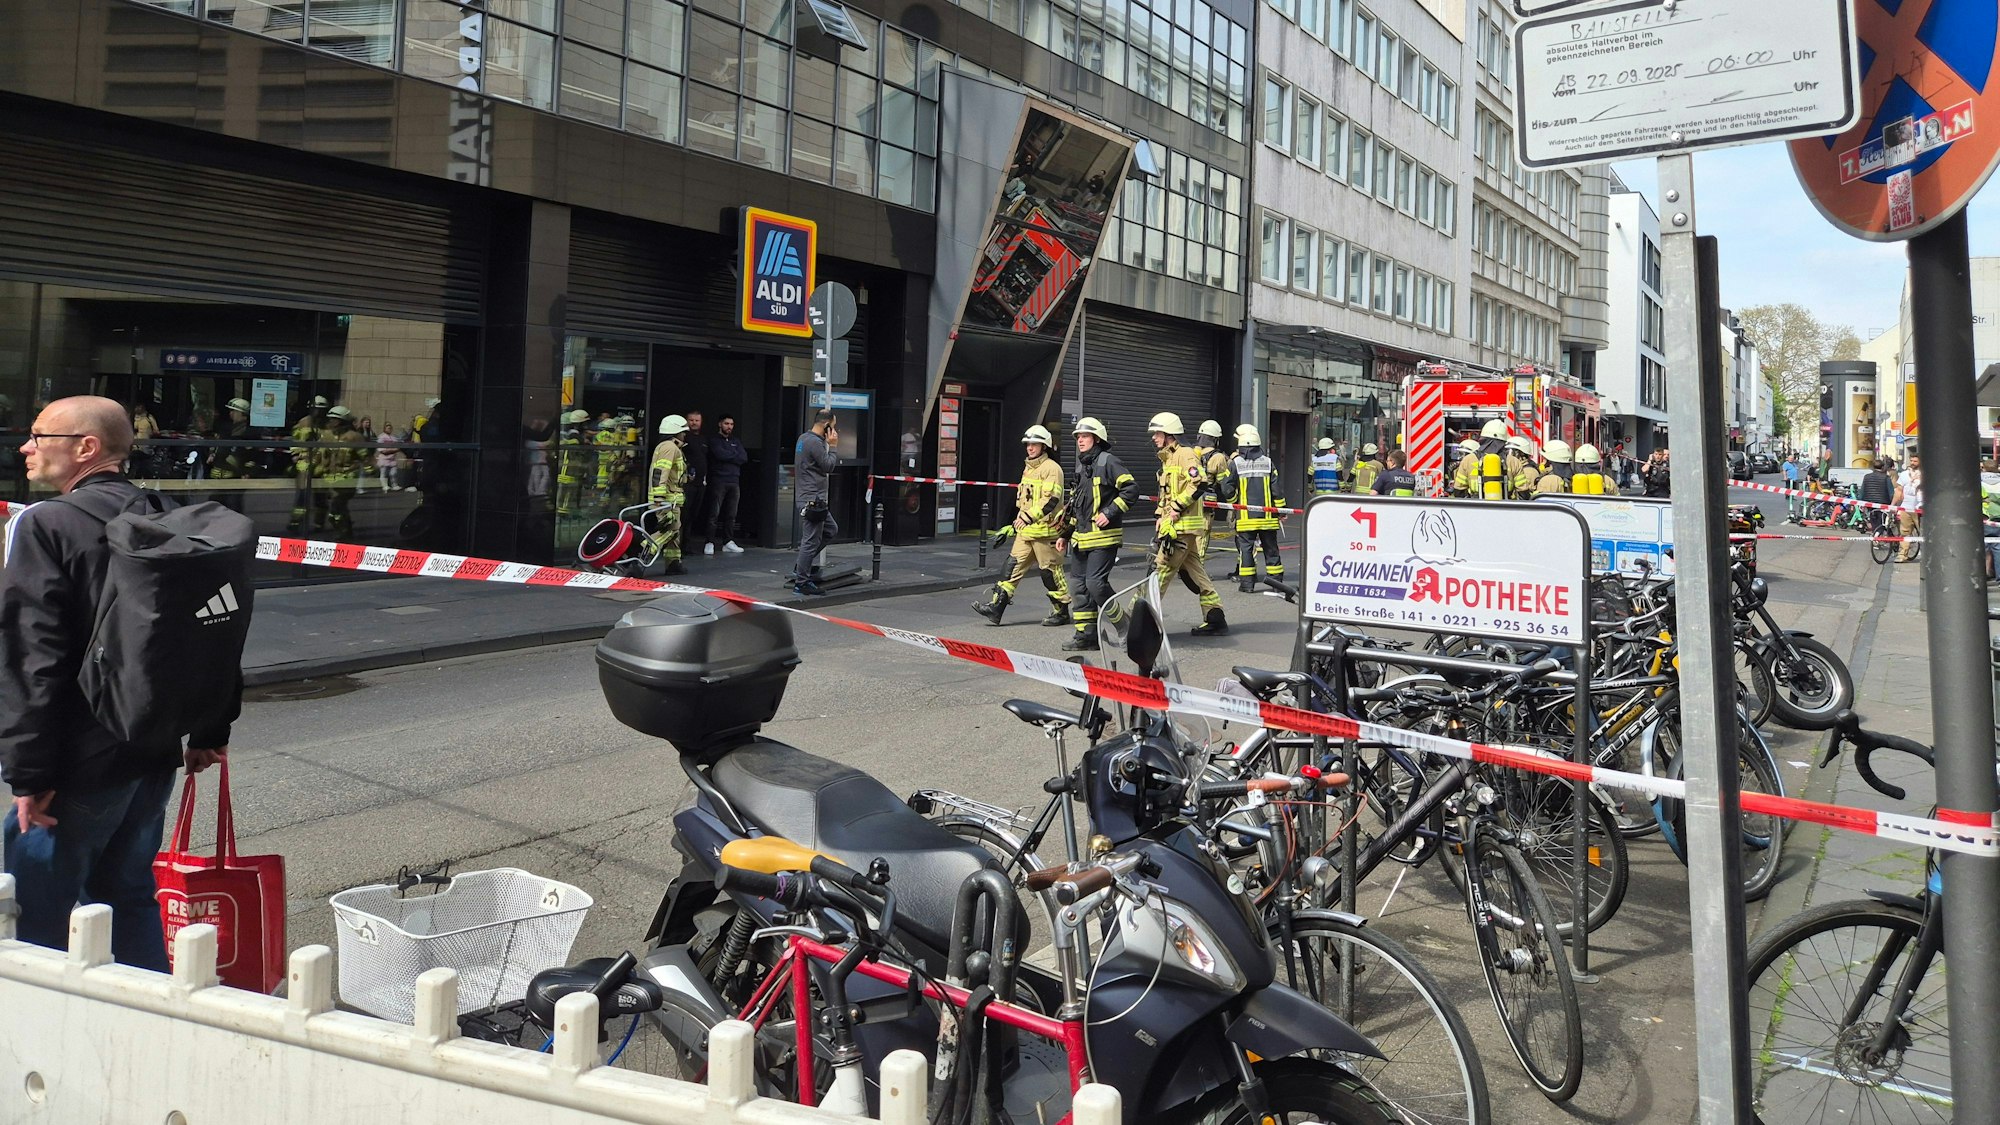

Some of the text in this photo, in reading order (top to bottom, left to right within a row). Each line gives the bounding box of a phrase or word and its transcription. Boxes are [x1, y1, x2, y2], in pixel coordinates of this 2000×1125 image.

[1546, 31, 1654, 56] absolutes Haltverbot im
[1546, 38, 1663, 65] gekennzeichneten Bereich
[1552, 49, 1817, 98] vom Uhr
[1555, 50, 1774, 91] AB 22.09.2025 06:00
[1531, 81, 1819, 130] bis zum Uhr
[1548, 105, 1819, 147] Widerrechtlich geparkte Fahrzeuge werden kostenpflichtig abgeschleppt.
[1565, 143, 1583, 151] Auch
[1597, 138, 1614, 146] dem
[1703, 124, 1718, 133] und
[1720, 122, 1727, 130] in
[1729, 120, 1744, 129] den
[1746, 115, 1800, 128] Haltebuchten.
[1892, 212, 1912, 228] CLUB
[756, 279, 802, 305] ALDI
[770, 303, 788, 316] SÜD
[1349, 541, 1377, 552] 50 m
[1319, 555, 1569, 616] SCHWANEN APOTHEKE
[1337, 584, 1387, 597] SEIT 1634
[203, 616, 231, 626] BOXING
[1314, 602, 1350, 615] Breite
[1354, 606, 1395, 620] Straße
[1401, 611, 1424, 622] 141
[1443, 615, 1477, 627] 0221
[1493, 619, 1520, 631] 925
[1527, 622, 1545, 634] 36
[1551, 625, 1569, 636] 54
[1595, 705, 1659, 766] CUBE
[168, 898, 220, 918] REWE
[1248, 1017, 1266, 1030] ABS
